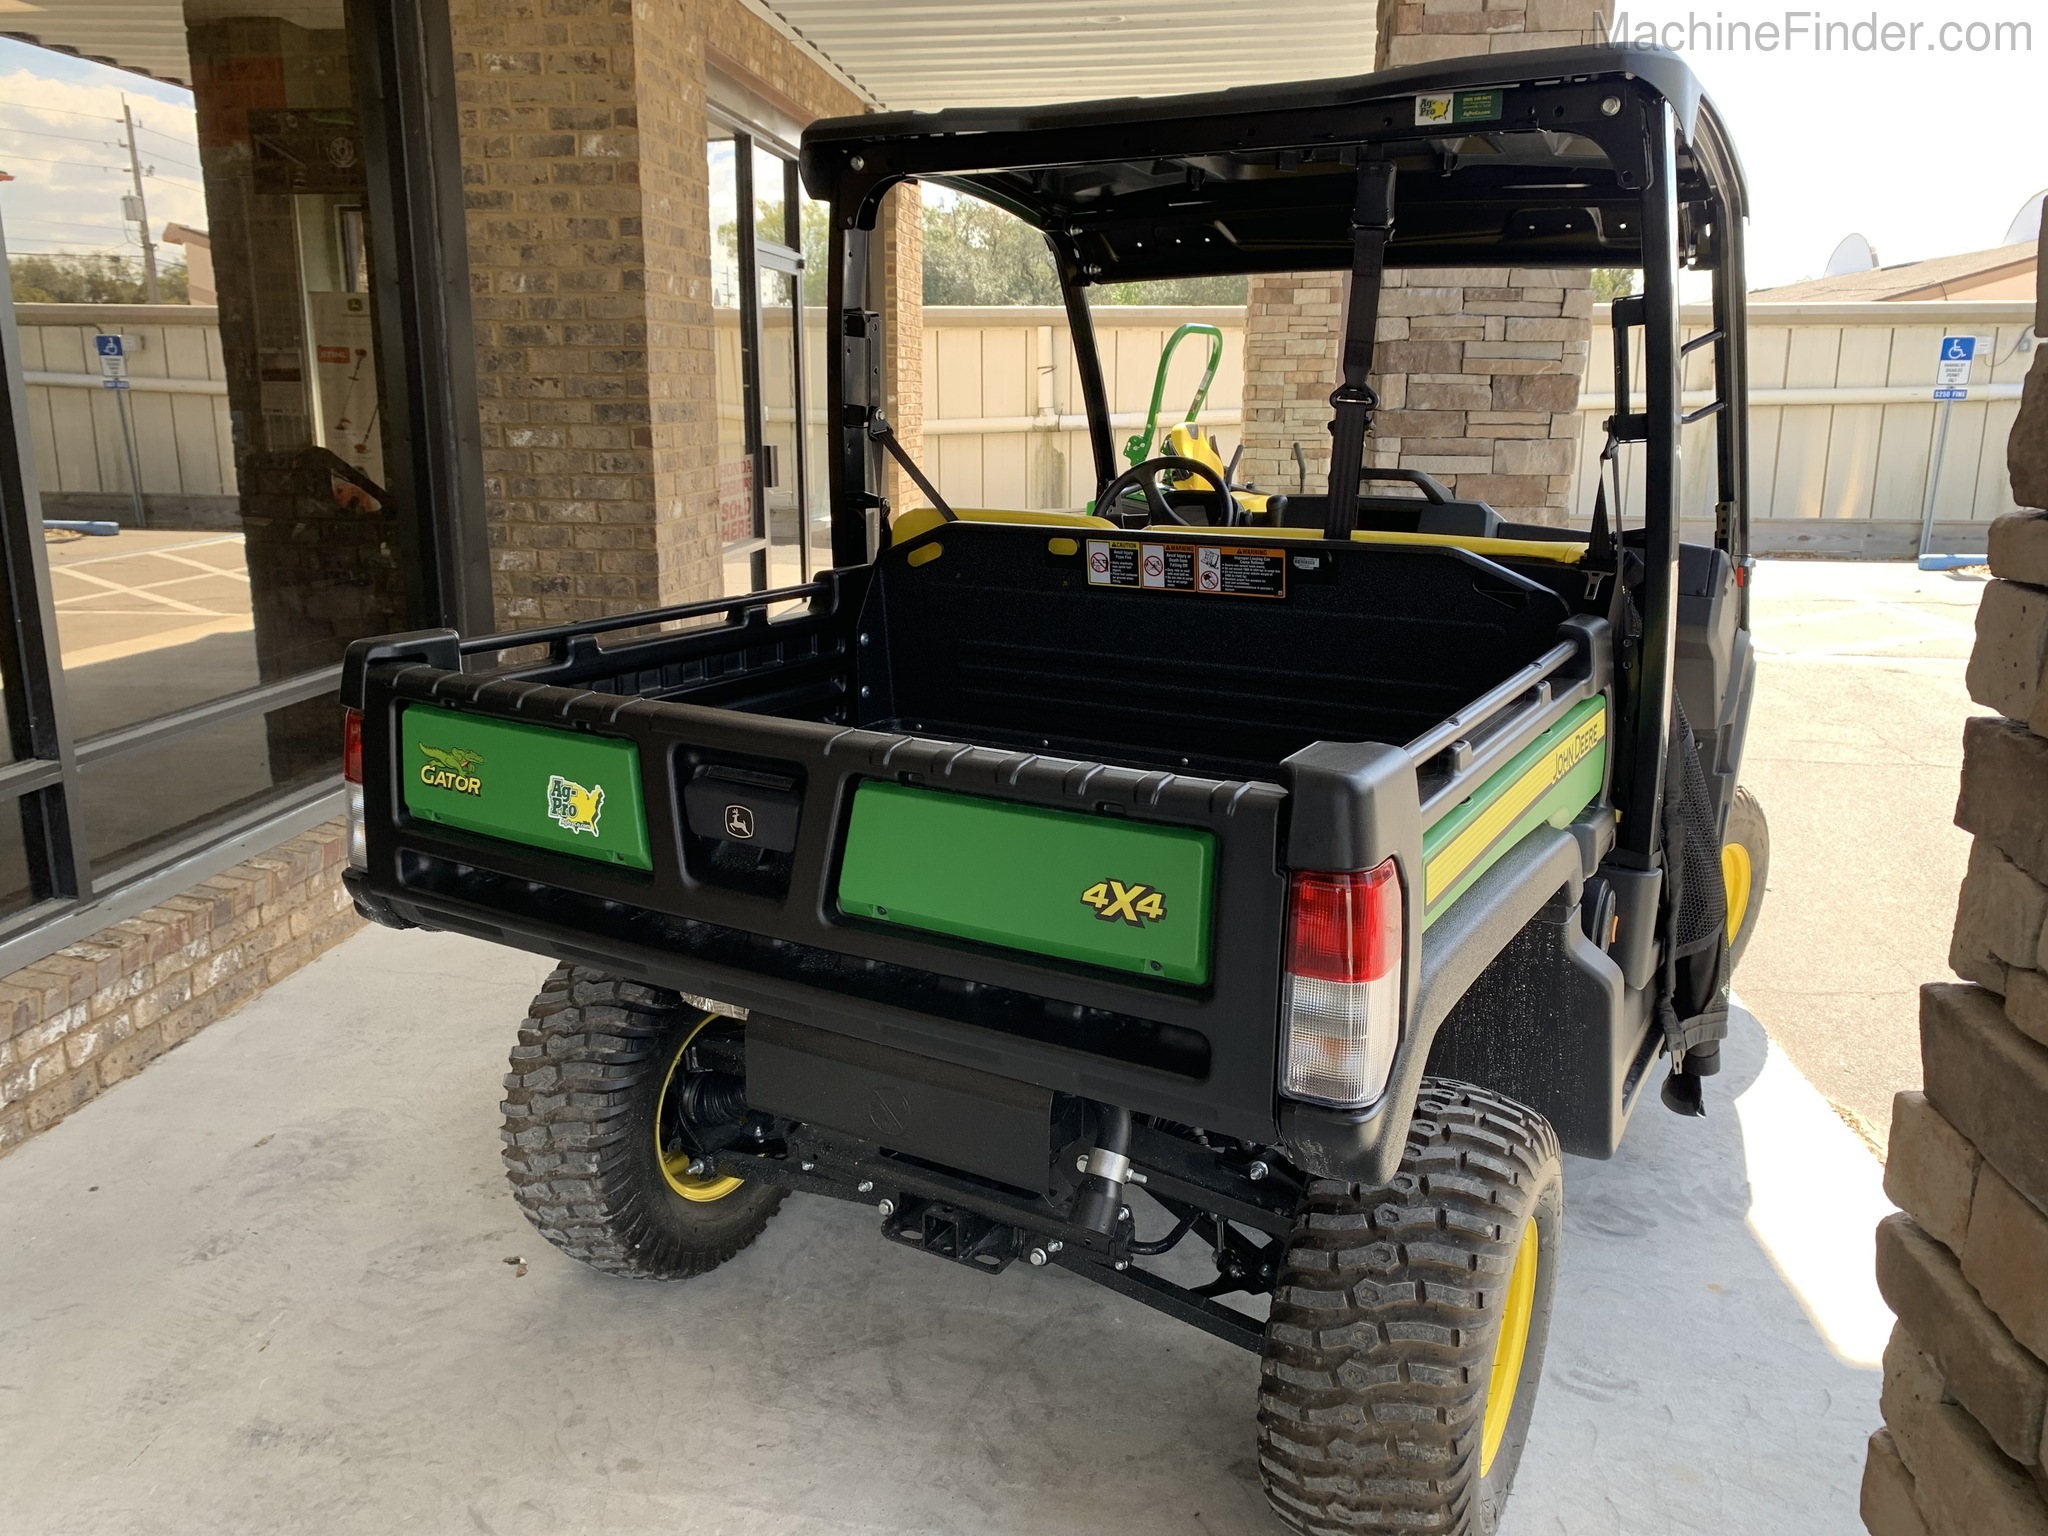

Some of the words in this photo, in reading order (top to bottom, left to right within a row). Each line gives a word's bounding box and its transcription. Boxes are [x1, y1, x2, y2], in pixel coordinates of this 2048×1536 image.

[1419, 107, 1436, 117] Pro
[1935, 390, 1950, 398] $250
[1952, 390, 1966, 398] FINE
[720, 460, 752, 478] HONDA
[721, 496, 752, 522] SOLD
[721, 517, 752, 542] HERE
[1116, 541, 1136, 549] CAUTION
[1170, 544, 1194, 552] WARNING
[1242, 548, 1267, 556] WARNING
[1552, 743, 1575, 782] JOHN
[1574, 723, 1598, 761] DEERE
[421, 764, 482, 797] GATOR
[551, 779, 577, 802] Ag-
[551, 797, 577, 817] Pro
